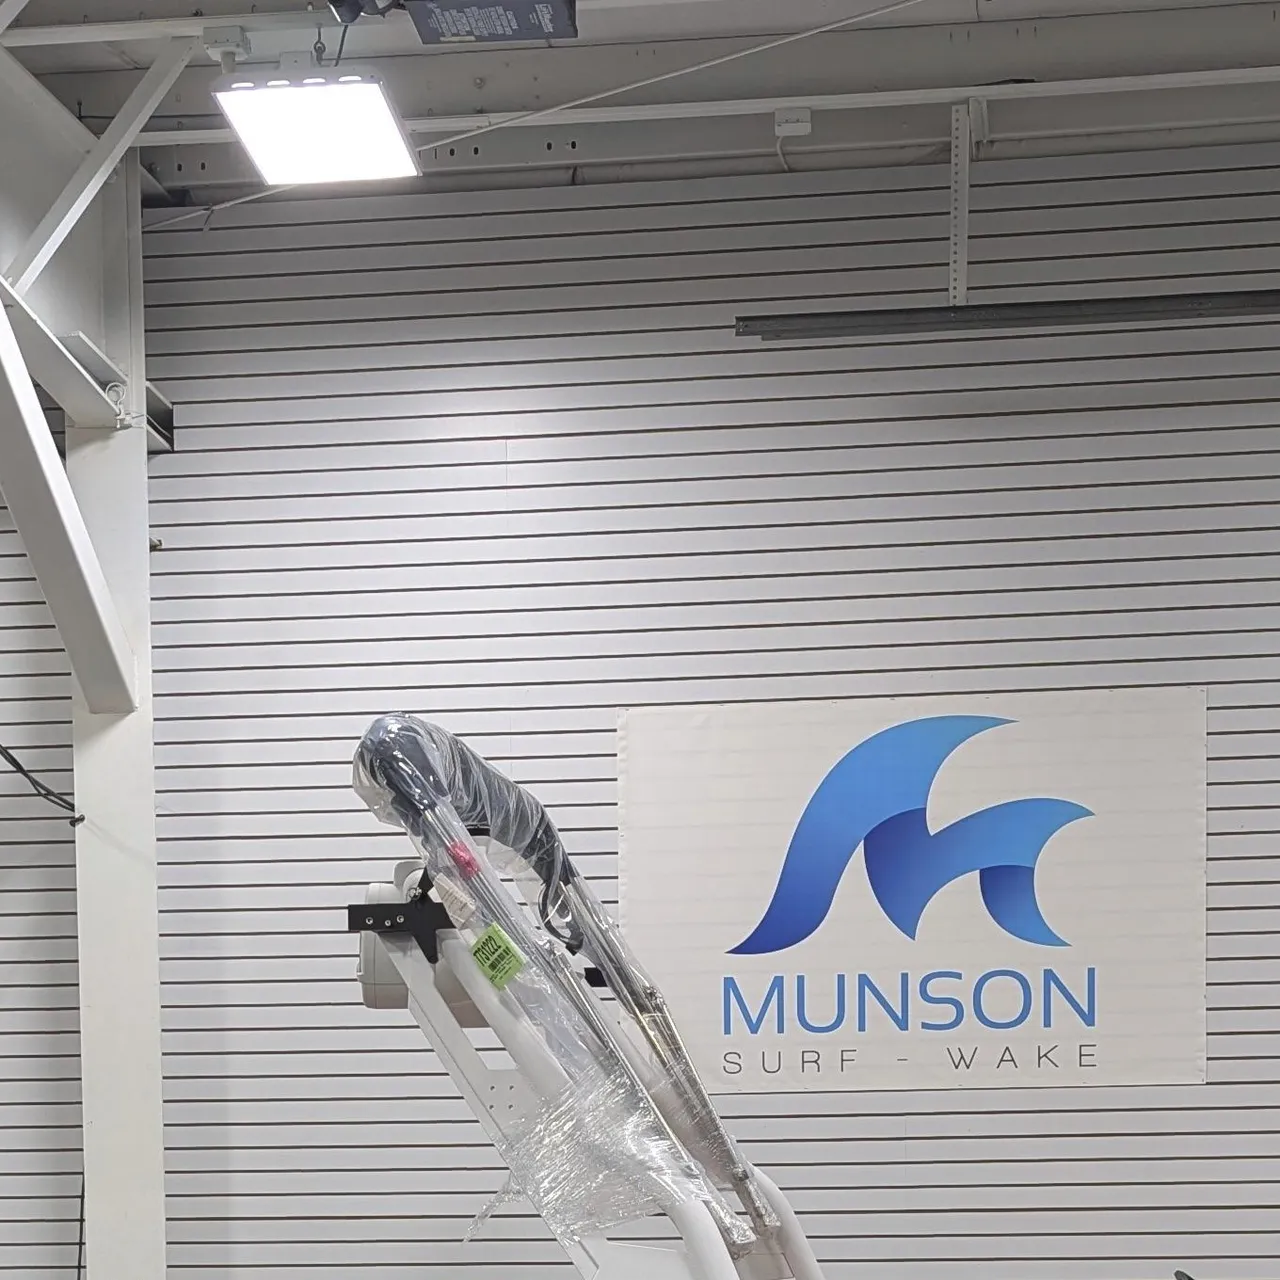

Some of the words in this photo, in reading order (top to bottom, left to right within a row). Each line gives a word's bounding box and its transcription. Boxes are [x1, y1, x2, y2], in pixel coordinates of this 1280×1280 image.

[723, 967, 1097, 1036] MUNSON
[722, 1048, 858, 1076] SURF
[946, 1043, 1098, 1070] WAKE
